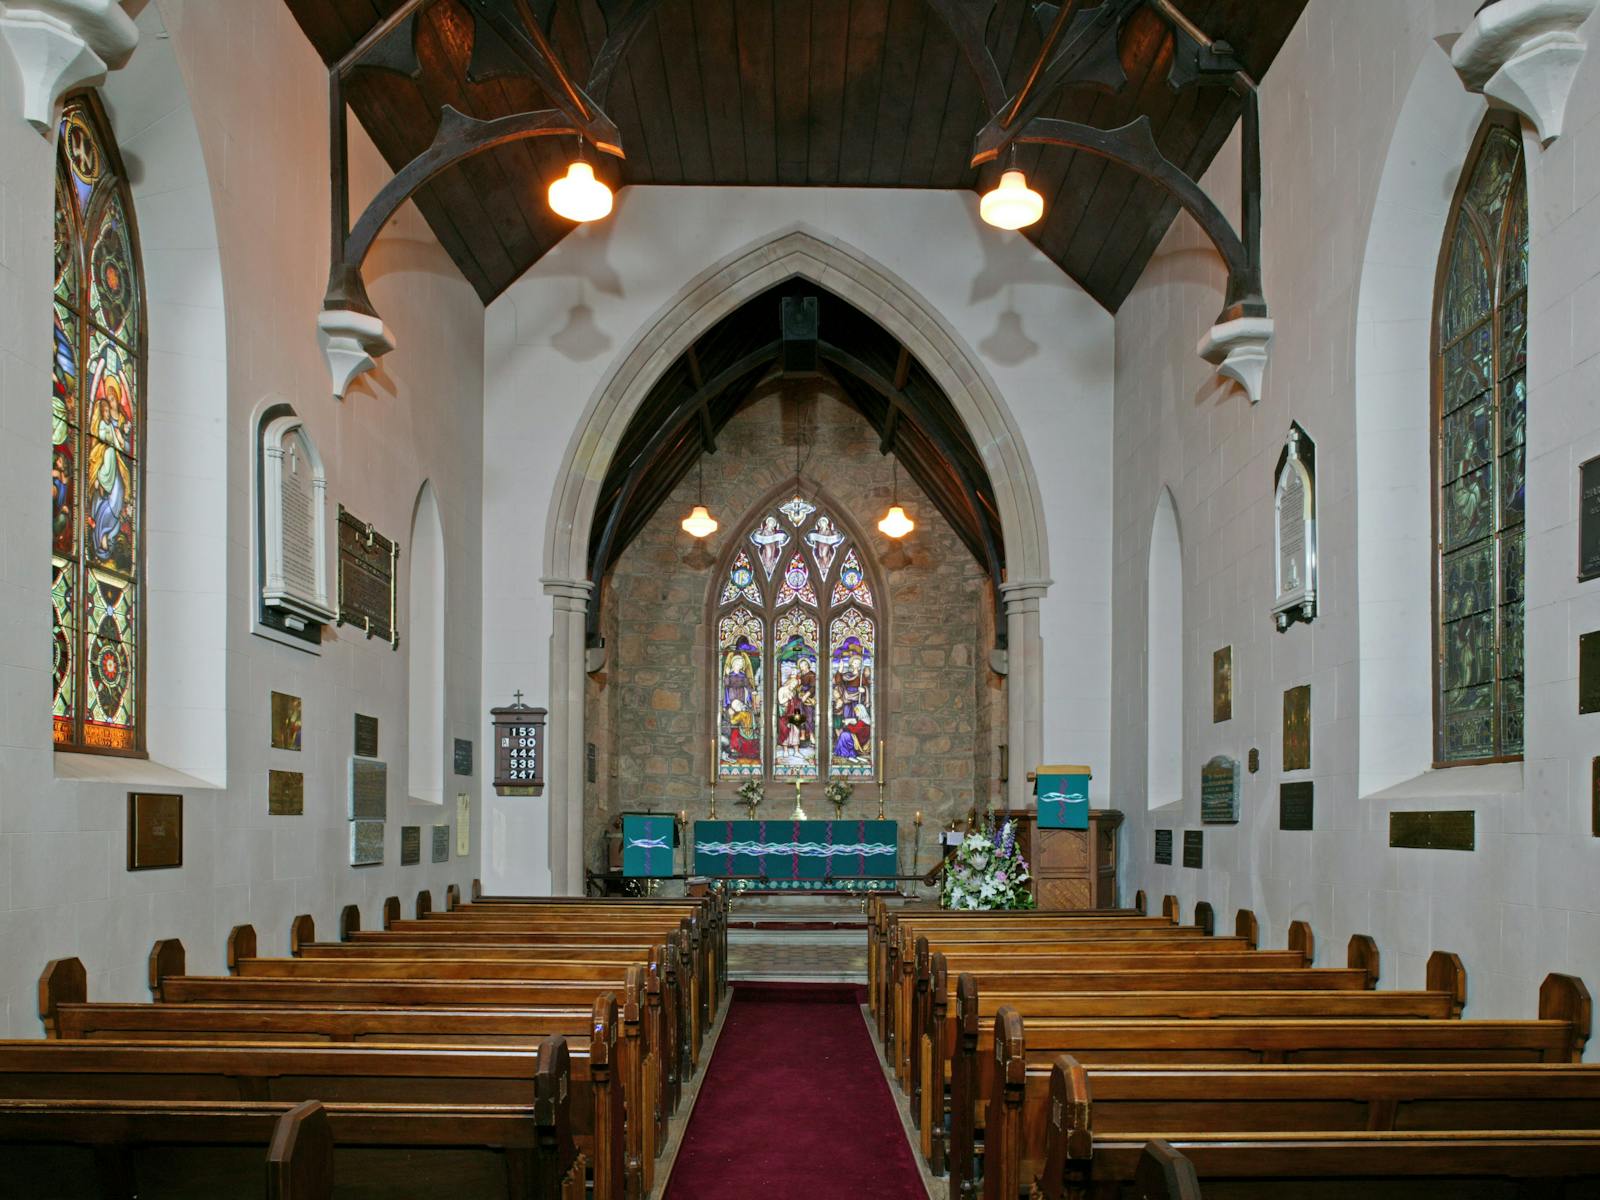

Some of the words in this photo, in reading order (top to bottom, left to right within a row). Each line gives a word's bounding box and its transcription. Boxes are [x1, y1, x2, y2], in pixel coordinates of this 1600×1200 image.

[512, 727, 536, 736] 153
[519, 738, 536, 747] 90
[510, 748, 536, 758] 444
[510, 759, 535, 768] 538
[510, 770, 535, 779] 247
